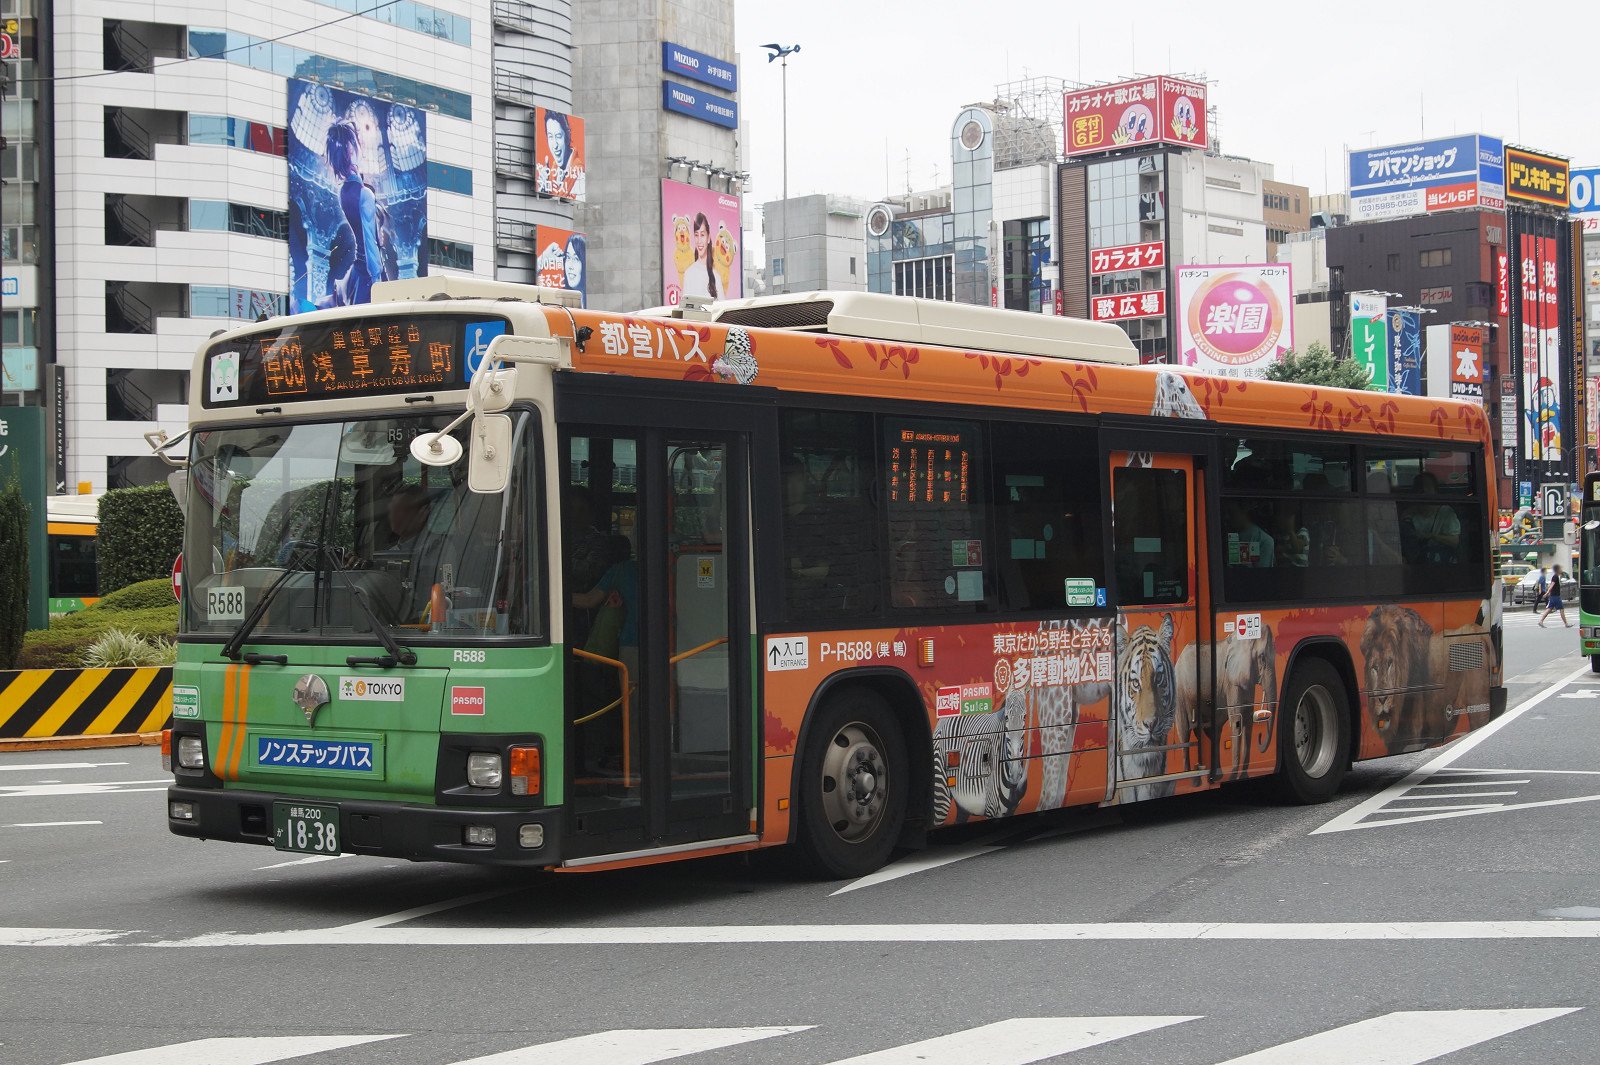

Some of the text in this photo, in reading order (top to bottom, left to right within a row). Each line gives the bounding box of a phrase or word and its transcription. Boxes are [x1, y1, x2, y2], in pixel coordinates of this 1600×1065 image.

[674, 51, 699, 68] MIZUHO
[707, 65, 732, 82] みずほ銀行
[672, 89, 696, 105] MIZUHO
[1069, 83, 1156, 113] カラオケ歌広場
[1164, 81, 1204, 100] カラオケ歌広場
[1075, 117, 1099, 132] 受付
[1076, 131, 1099, 145] 6F
[1368, 147, 1457, 179] アパマンショップ
[719, 196, 737, 208] docomo
[1428, 190, 1475, 206] 当ビル6F
[1094, 246, 1161, 271] カラオケ
[1180, 270, 1209, 278] パチンコ
[1522, 257, 1557, 288] 免税
[1421, 291, 1452, 300] アイフル
[1500, 268, 1508, 314] アイフル
[1539, 288, 1557, 304] Free
[1096, 293, 1160, 318] 歌広場
[1204, 302, 1268, 335] 楽園
[599, 320, 707, 362] 都営バス
[1193, 330, 1279, 365] EXCITING AMUSEMENT
[312, 341, 452, 382] 浅草寿町
[1364, 325, 1376, 382] レイク
[1456, 348, 1479, 380] 本
[209, 592, 242, 614] R588
[783, 642, 803, 656] 入口
[993, 628, 1111, 654] 東京だから野生と会える
[453, 650, 486, 662] R588
[820, 639, 873, 662] P-R588
[780, 658, 807, 667] ENTRANCE
[1013, 651, 1112, 689] 多摩動物公園
[367, 683, 402, 695] TOKYO
[963, 686, 990, 698] PASMO
[453, 696, 483, 705] PASMO
[964, 701, 989, 713] Suica
[259, 741, 372, 767] ノンステップバス
[305, 808, 321, 820] 200
